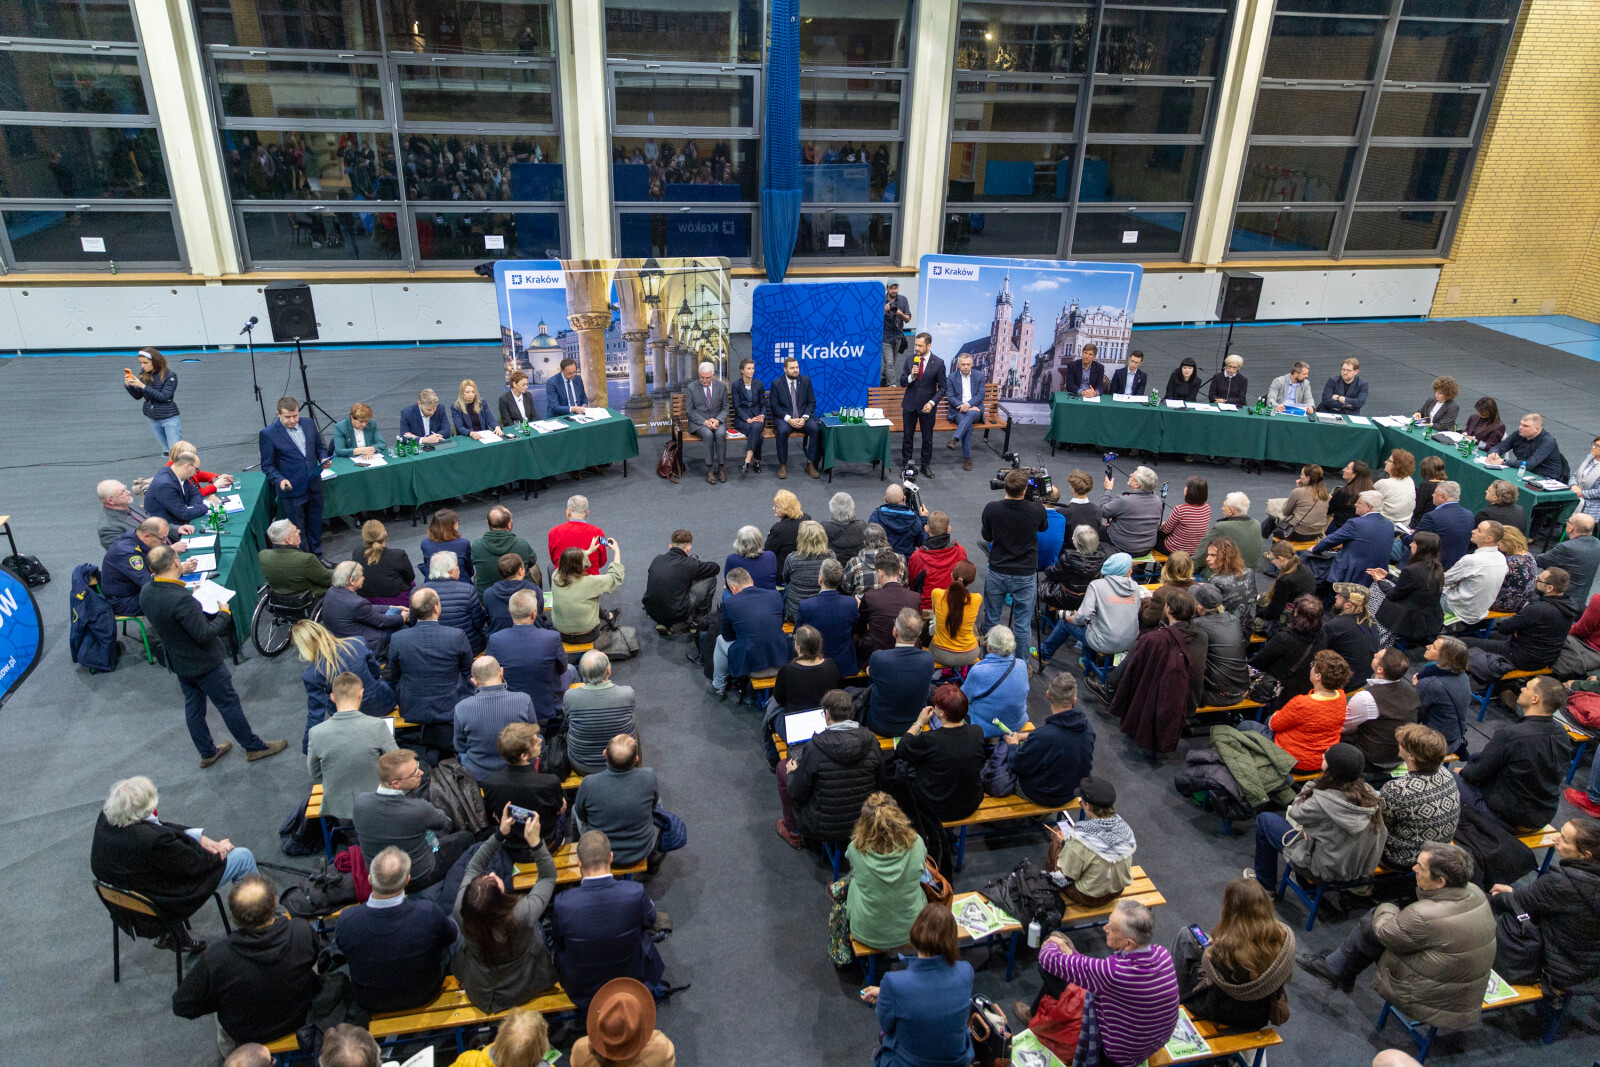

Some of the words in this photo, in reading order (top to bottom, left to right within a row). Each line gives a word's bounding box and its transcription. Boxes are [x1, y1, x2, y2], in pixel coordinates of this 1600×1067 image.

[944, 267, 974, 276] Kraków
[525, 275, 560, 284] Kraków
[801, 341, 865, 360] Kraków
[650, 418, 673, 427] www.
[0, 587, 18, 629] w
